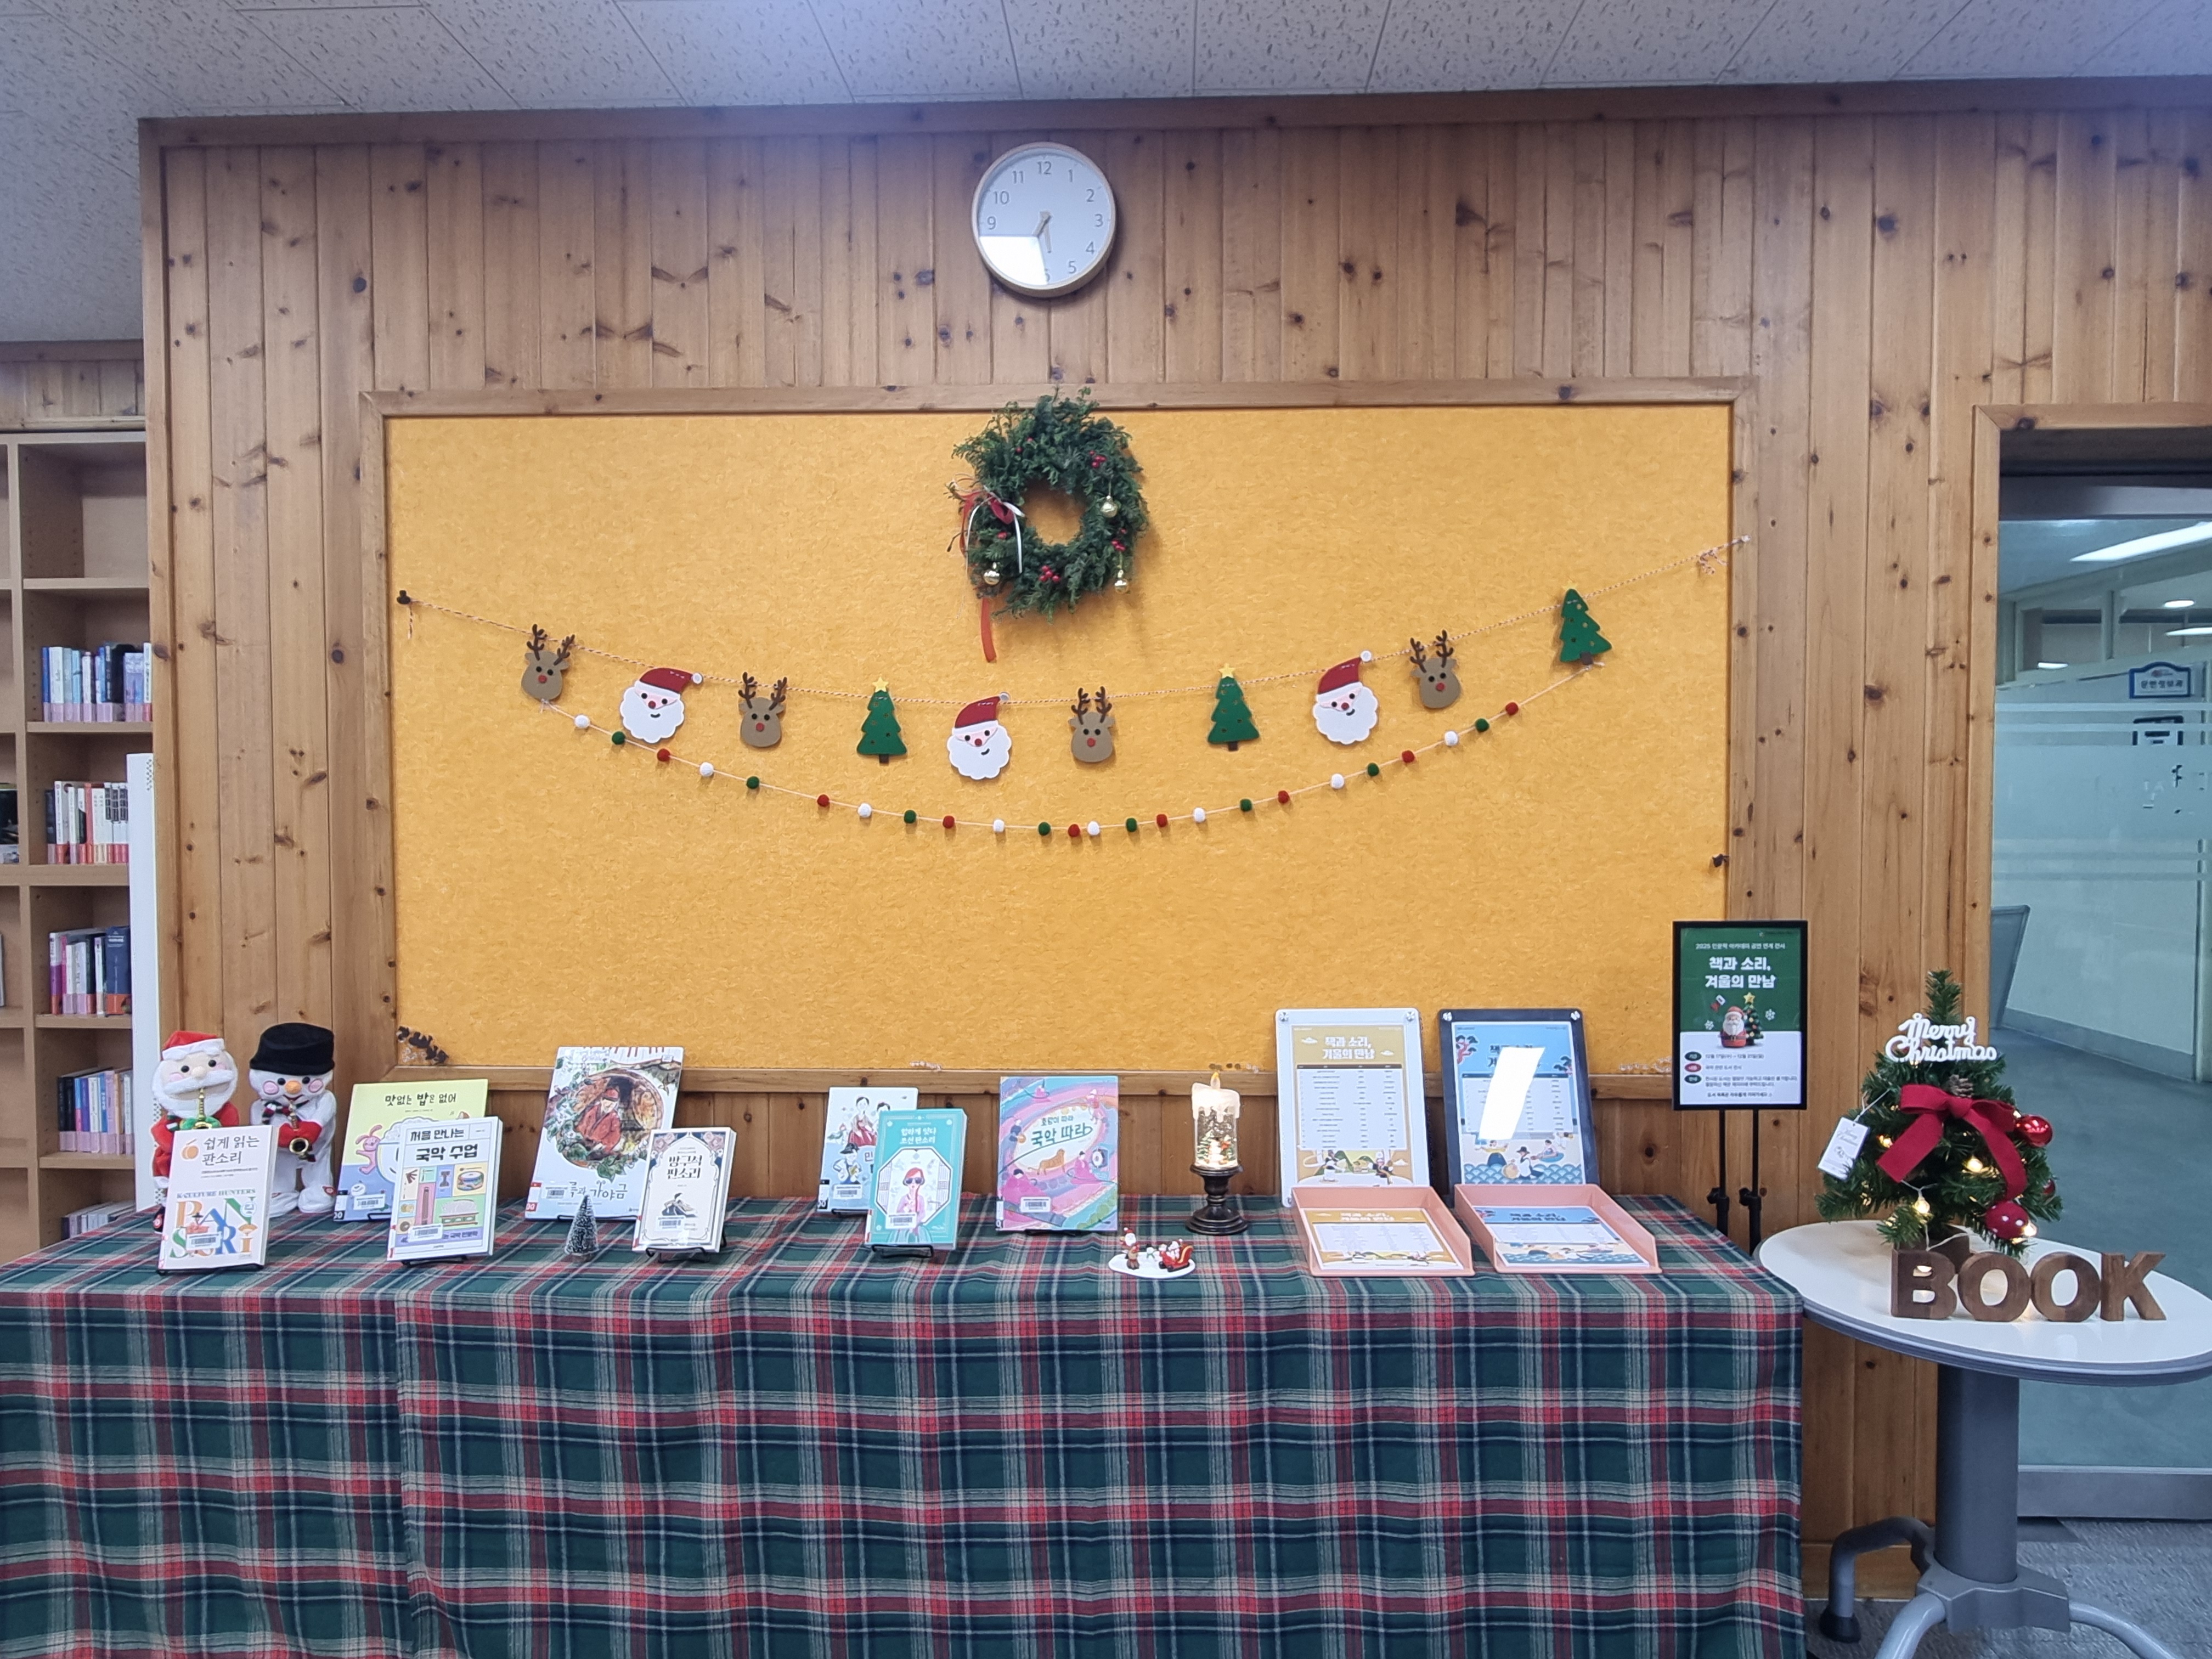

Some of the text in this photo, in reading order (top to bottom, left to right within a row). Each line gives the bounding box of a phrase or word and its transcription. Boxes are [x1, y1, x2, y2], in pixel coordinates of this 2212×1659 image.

[1037, 161, 1052, 174] 12
[1012, 170, 1024, 184] 11
[1068, 169, 1073, 183] 1
[994, 190, 1009, 205] 10
[1086, 189, 1094, 202] 2
[988, 216, 996, 230] 9
[1094, 213, 1103, 227] 3
[1085, 241, 1094, 254] 4
[1068, 261, 1076, 274] 5
[1709, 957, 1771, 971] 책과 소리,
[1705, 974, 1776, 988] 겨울의 만남
[1898, 1014, 1976, 1045] Merry
[1886, 1035, 1997, 1062] Christmas
[385, 1092, 456, 1107] 맛없는 밥은 없어
[410, 1128, 464, 1141] 처음 만나는
[1031, 1122, 1093, 1147] 국악 따라
[204, 1135, 259, 1150] 쉽게 읽는
[202, 1151, 242, 1166] 판소리
[416, 1143, 478, 1162] 국악 수업
[669, 1155, 702, 1167] 방구석
[667, 1167, 701, 1180] 판소리
[218, 1188, 256, 1197] HUNTERS
[589, 1180, 628, 1200] 가야금
[1891, 1249, 2167, 1322] BOOK
